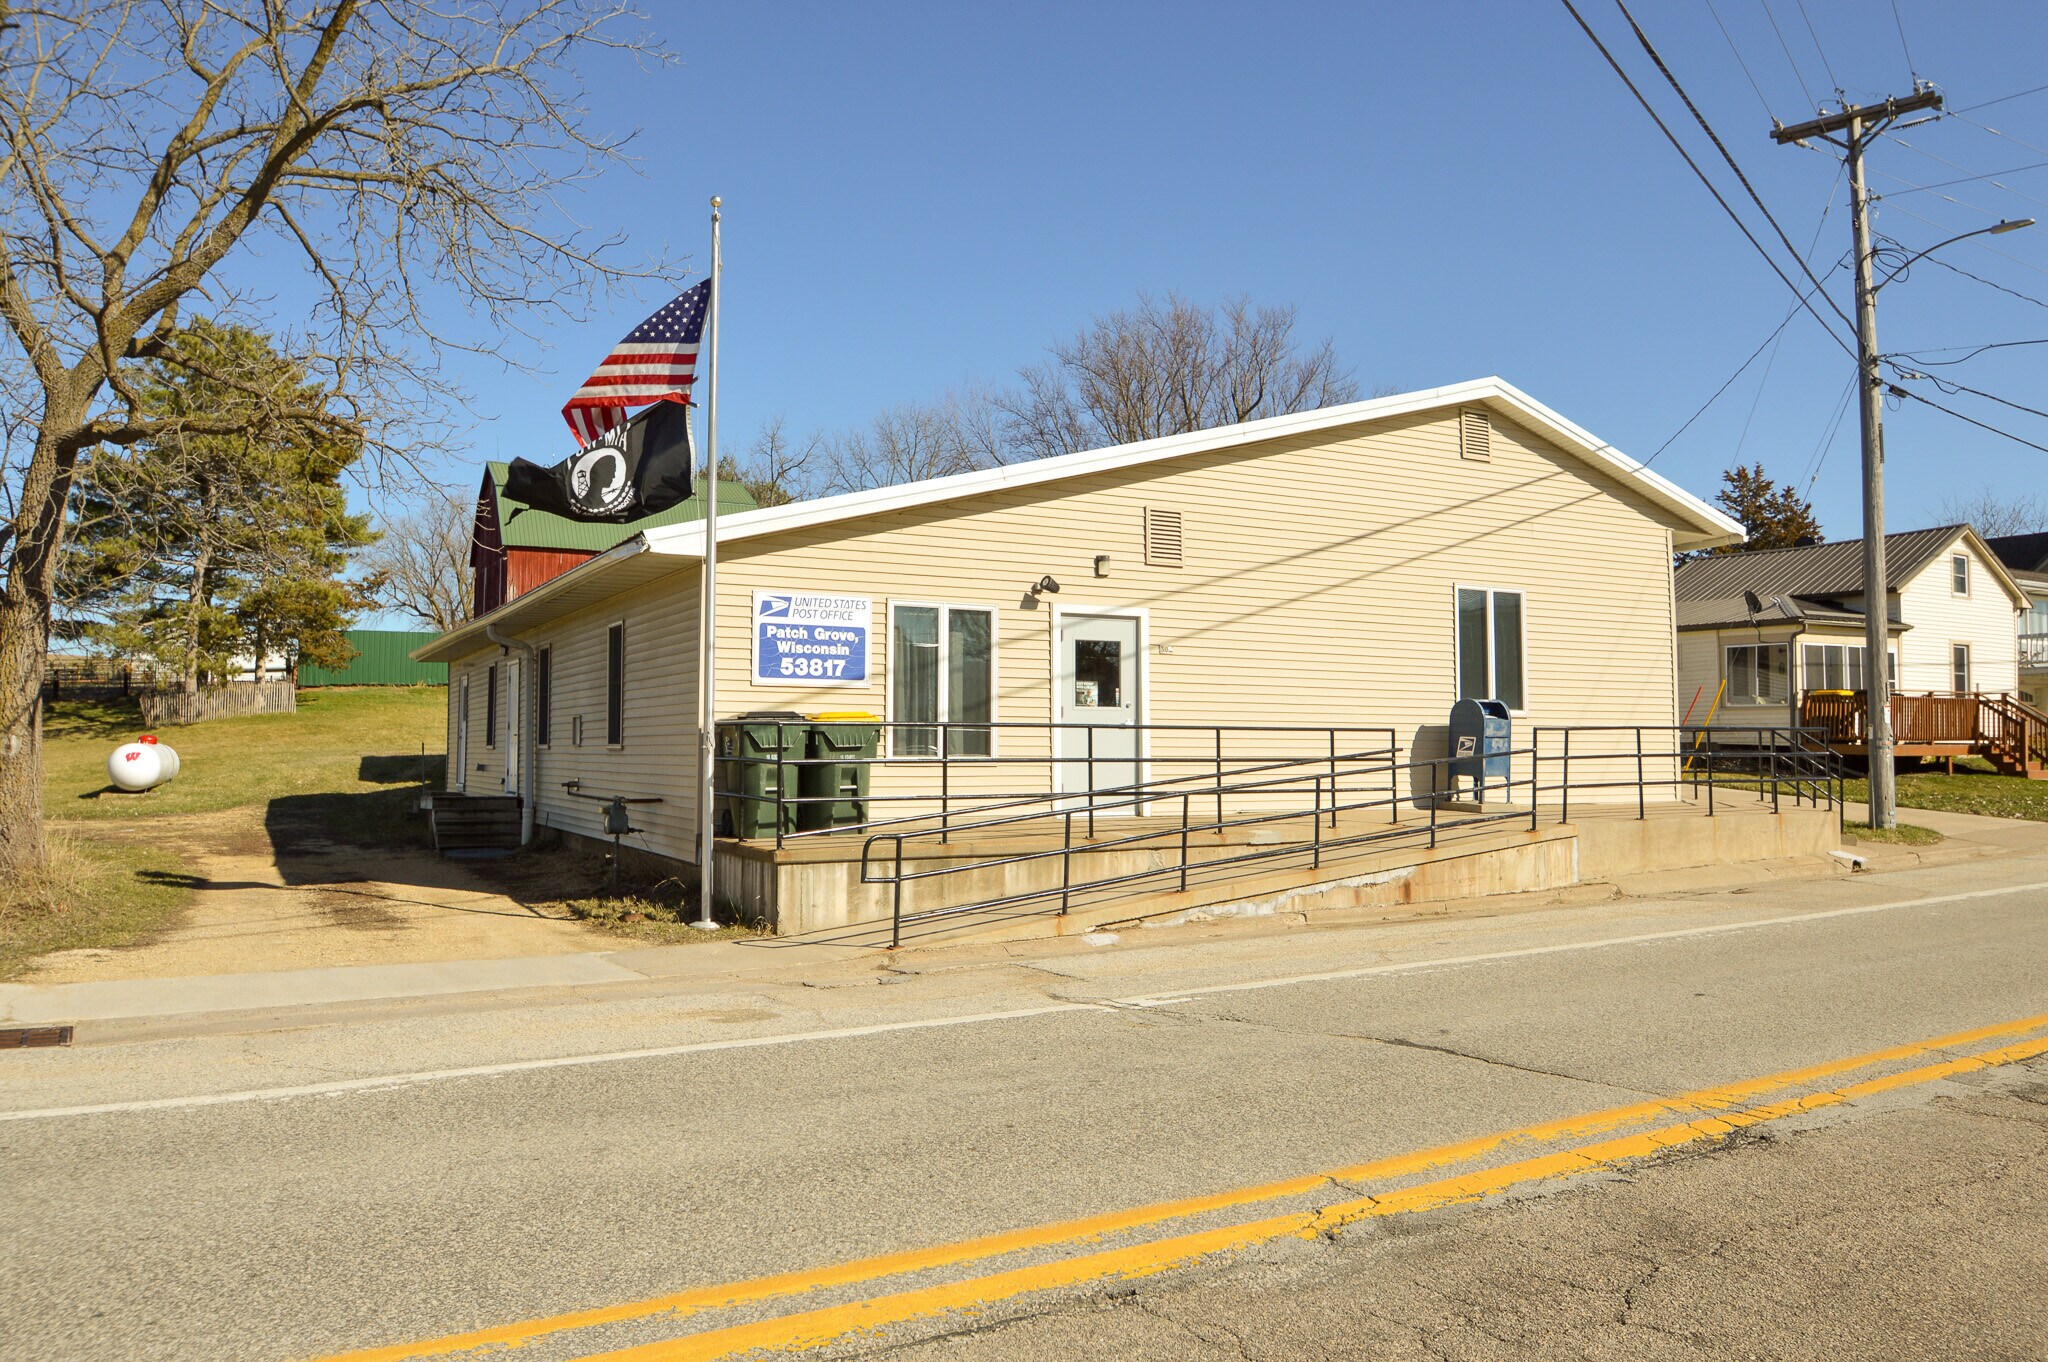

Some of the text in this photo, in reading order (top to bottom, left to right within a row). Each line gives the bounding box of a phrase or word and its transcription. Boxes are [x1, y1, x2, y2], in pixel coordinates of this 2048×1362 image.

[795, 597, 867, 610] UNITED STATES
[792, 608, 854, 621] POST OFFICE
[766, 625, 859, 643] Patch Grove,
[776, 641, 850, 656] Wisconsin
[780, 657, 846, 677] 53817
